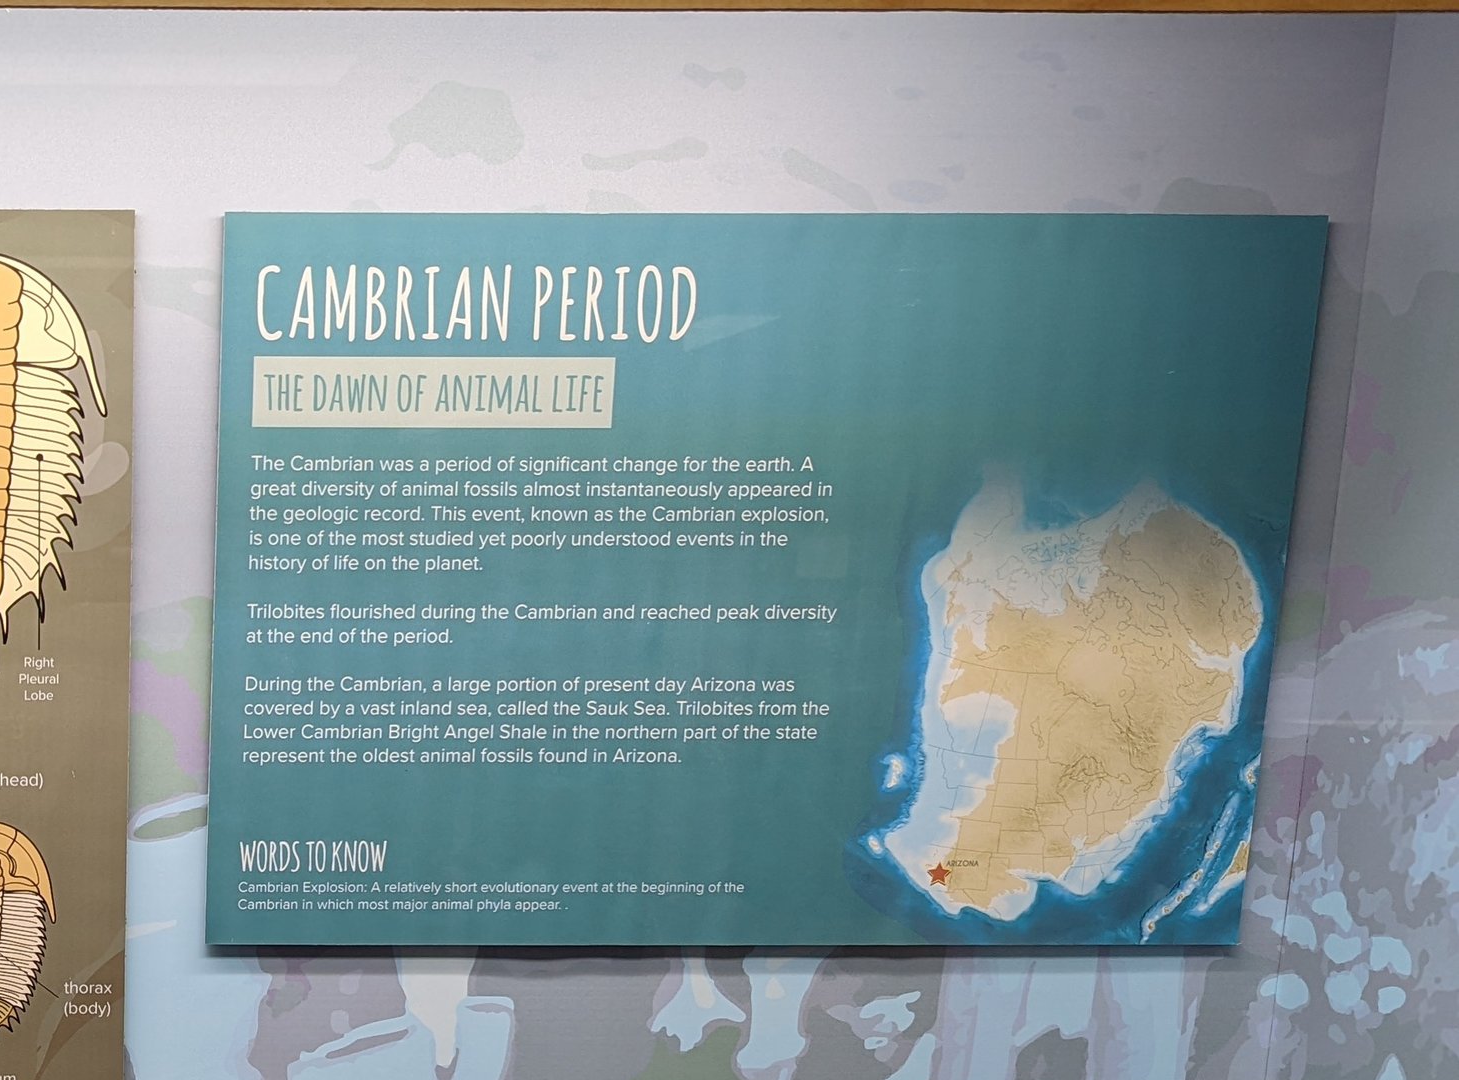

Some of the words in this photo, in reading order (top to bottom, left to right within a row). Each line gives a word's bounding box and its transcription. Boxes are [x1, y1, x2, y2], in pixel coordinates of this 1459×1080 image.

[257, 265, 511, 341] CAMBRIAN
[534, 265, 696, 342] PERIOD
[264, 374, 303, 411] THE
[314, 374, 387, 413] DAWN
[398, 374, 427, 412] OF
[435, 375, 542, 414] ANIMAL
[552, 375, 604, 412] LIFE
[251, 455, 284, 470] The
[291, 455, 373, 471] Cambrian
[380, 460, 413, 471] was
[420, 460, 429, 471] a
[436, 456, 491, 475] period
[497, 456, 515, 471] of
[519, 456, 608, 475] significant
[613, 457, 677, 475] change
[683, 456, 707, 471] for
[712, 457, 740, 471] the
[746, 457, 794, 471] earth.
[800, 457, 813, 471] A
[24, 657, 54, 670] Right
[19, 674, 59, 684] Pleural
[25, 690, 53, 700] Lobe
[240, 841, 300, 872] WORDS
[306, 841, 326, 872] TO
[332, 841, 387, 872] KNOW
[239, 882, 298, 892] Cambrian
[303, 882, 366, 894] Explosion:
[371, 882, 380, 892] A
[385, 882, 441, 895] relatively
[445, 882, 477, 892] short
[481, 882, 559, 895] evolutionary
[563, 883, 598, 892] event
[602, 883, 613, 892] at
[617, 882, 637, 892] the
[642, 882, 704, 895] beginning
[708, 882, 721, 892] of
[724, 882, 744, 892] the
[64, 981, 111, 994] thorax
[64, 1002, 110, 1017] (body)
